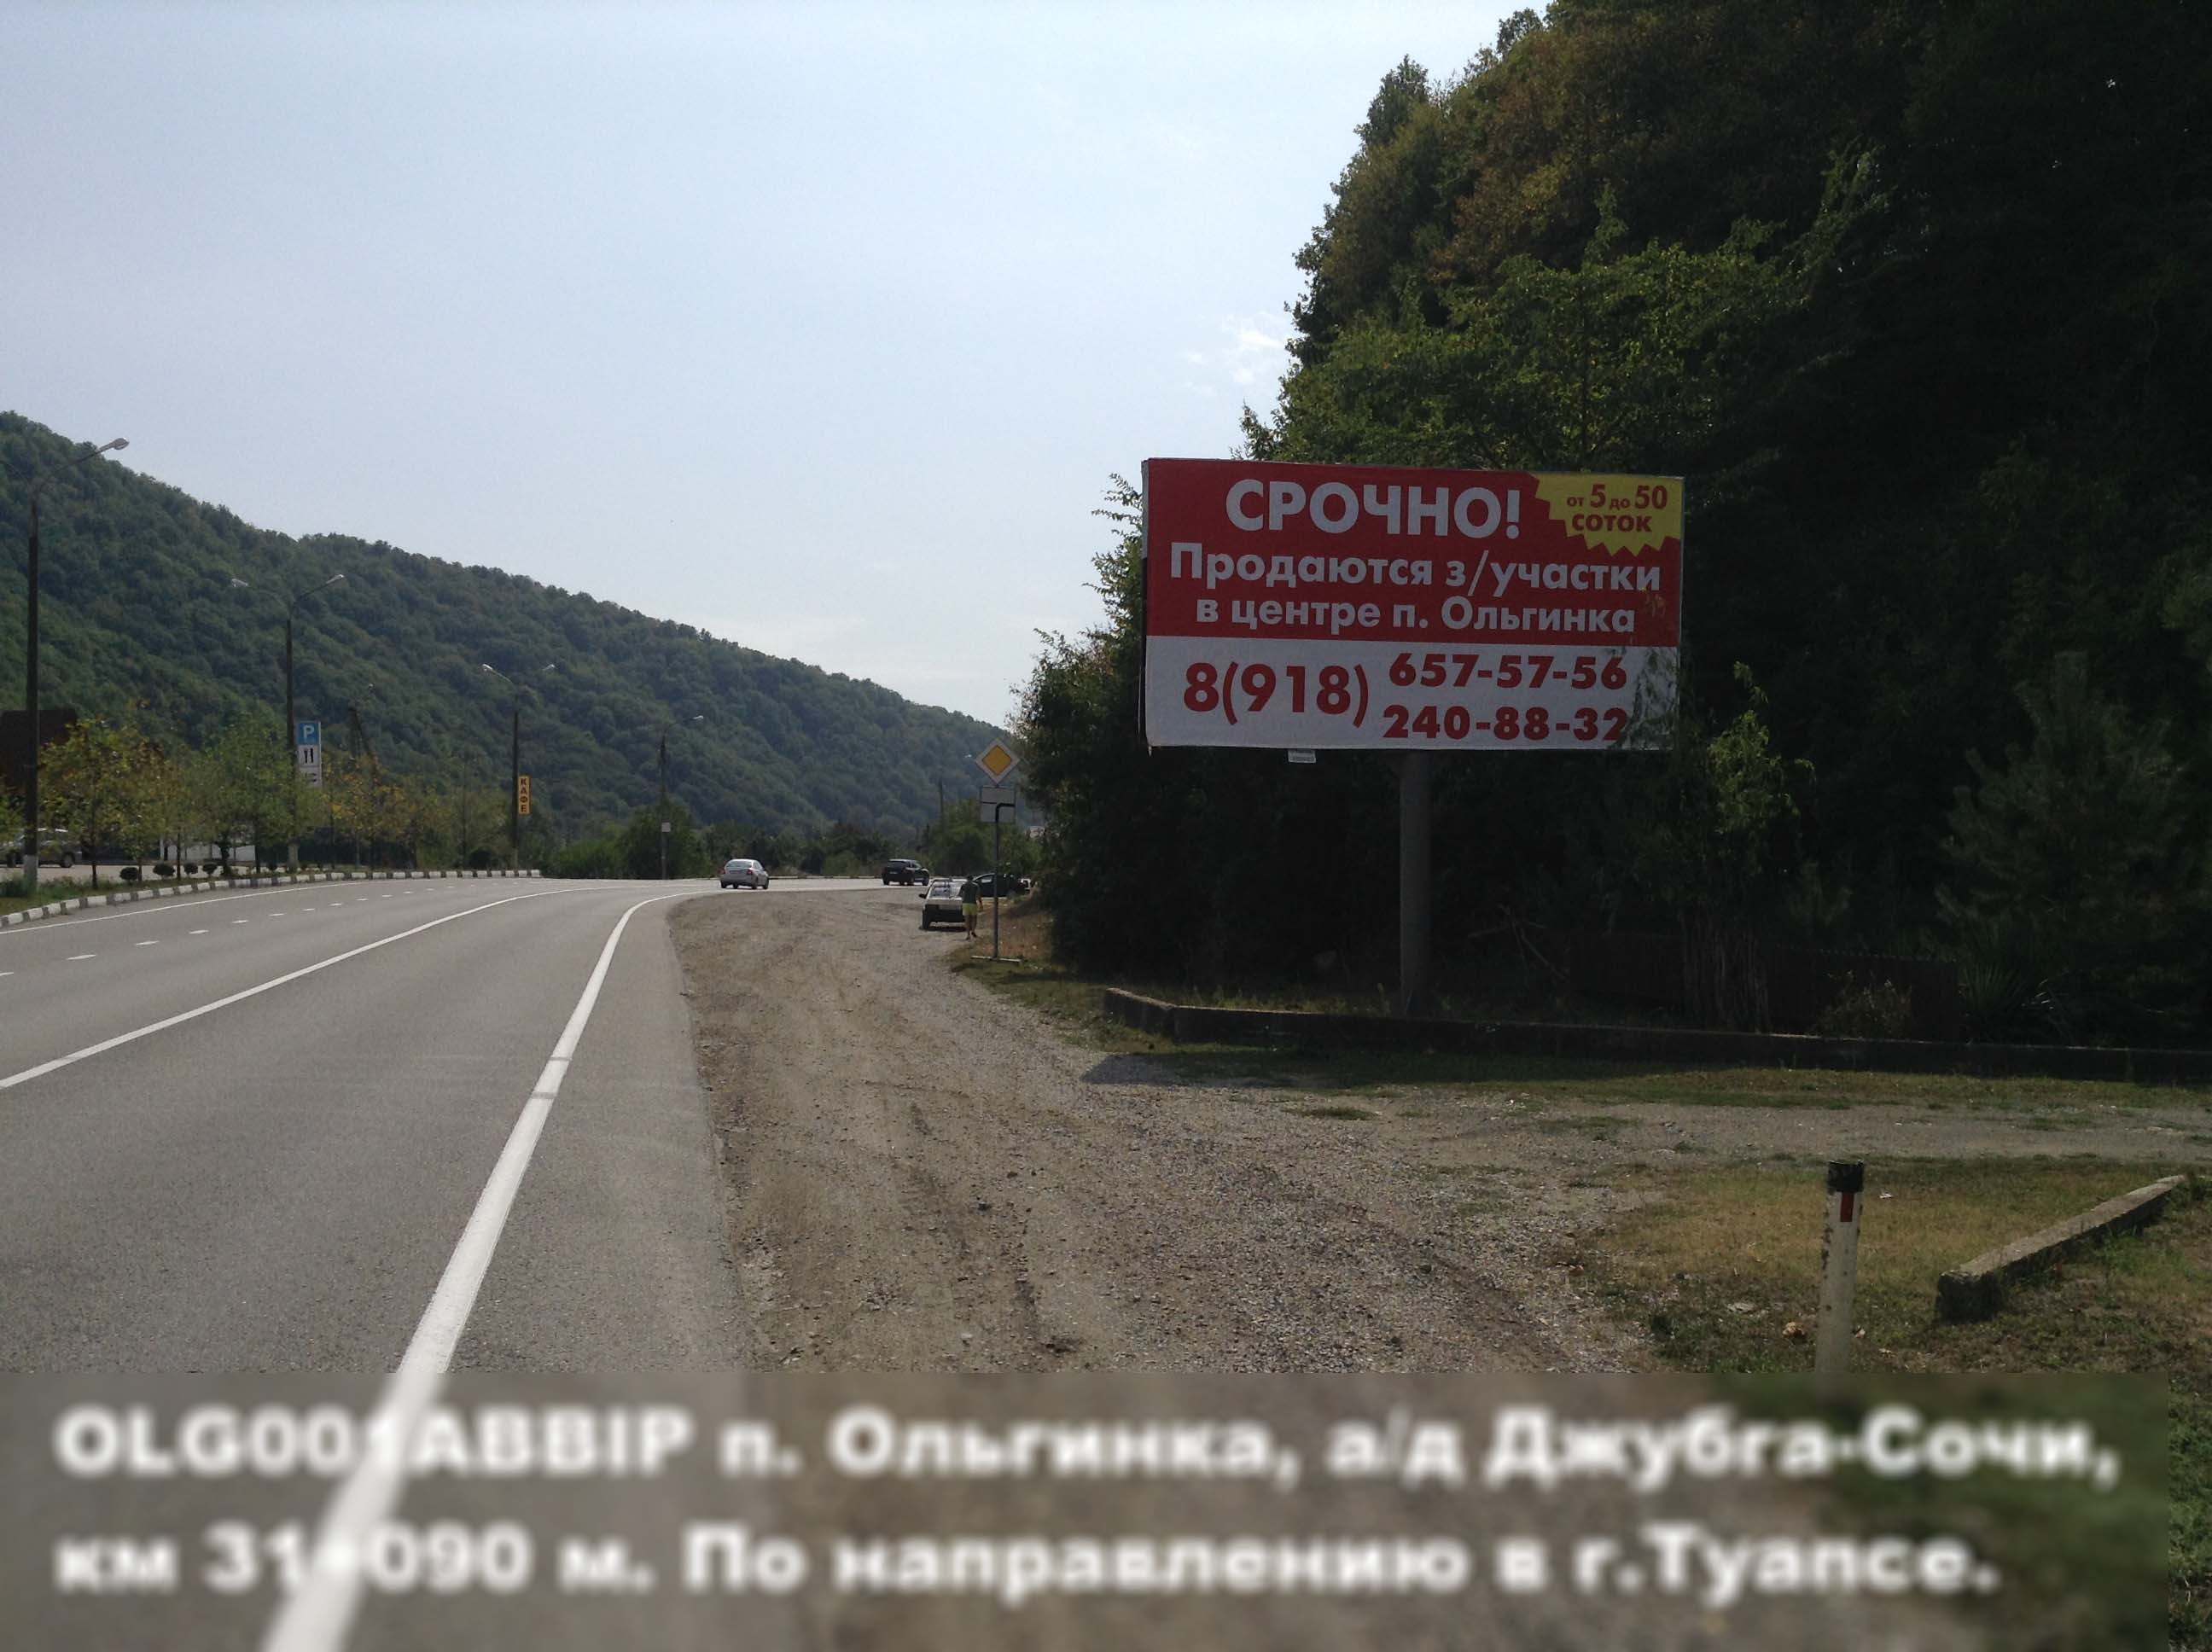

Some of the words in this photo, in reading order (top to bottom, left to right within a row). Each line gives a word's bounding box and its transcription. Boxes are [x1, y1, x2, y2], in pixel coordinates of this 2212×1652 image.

[1225, 479, 1521, 539] СРОЧНО!
[1590, 484, 1607, 509] 5
[1634, 485, 1668, 509] 50
[1170, 542, 1433, 590] Продаются
[1446, 550, 1661, 597] з/участки
[1196, 599, 1220, 623] в
[1231, 600, 1382, 635] центре
[1393, 604, 1429, 630] п.
[1441, 596, 1636, 633] Ольгинка
[1184, 660, 1368, 727] 8(918)
[1388, 653, 1627, 690] 657-57-56
[1382, 704, 1630, 741] 240-88-32
[520, 777, 528, 813] КАФЕ
